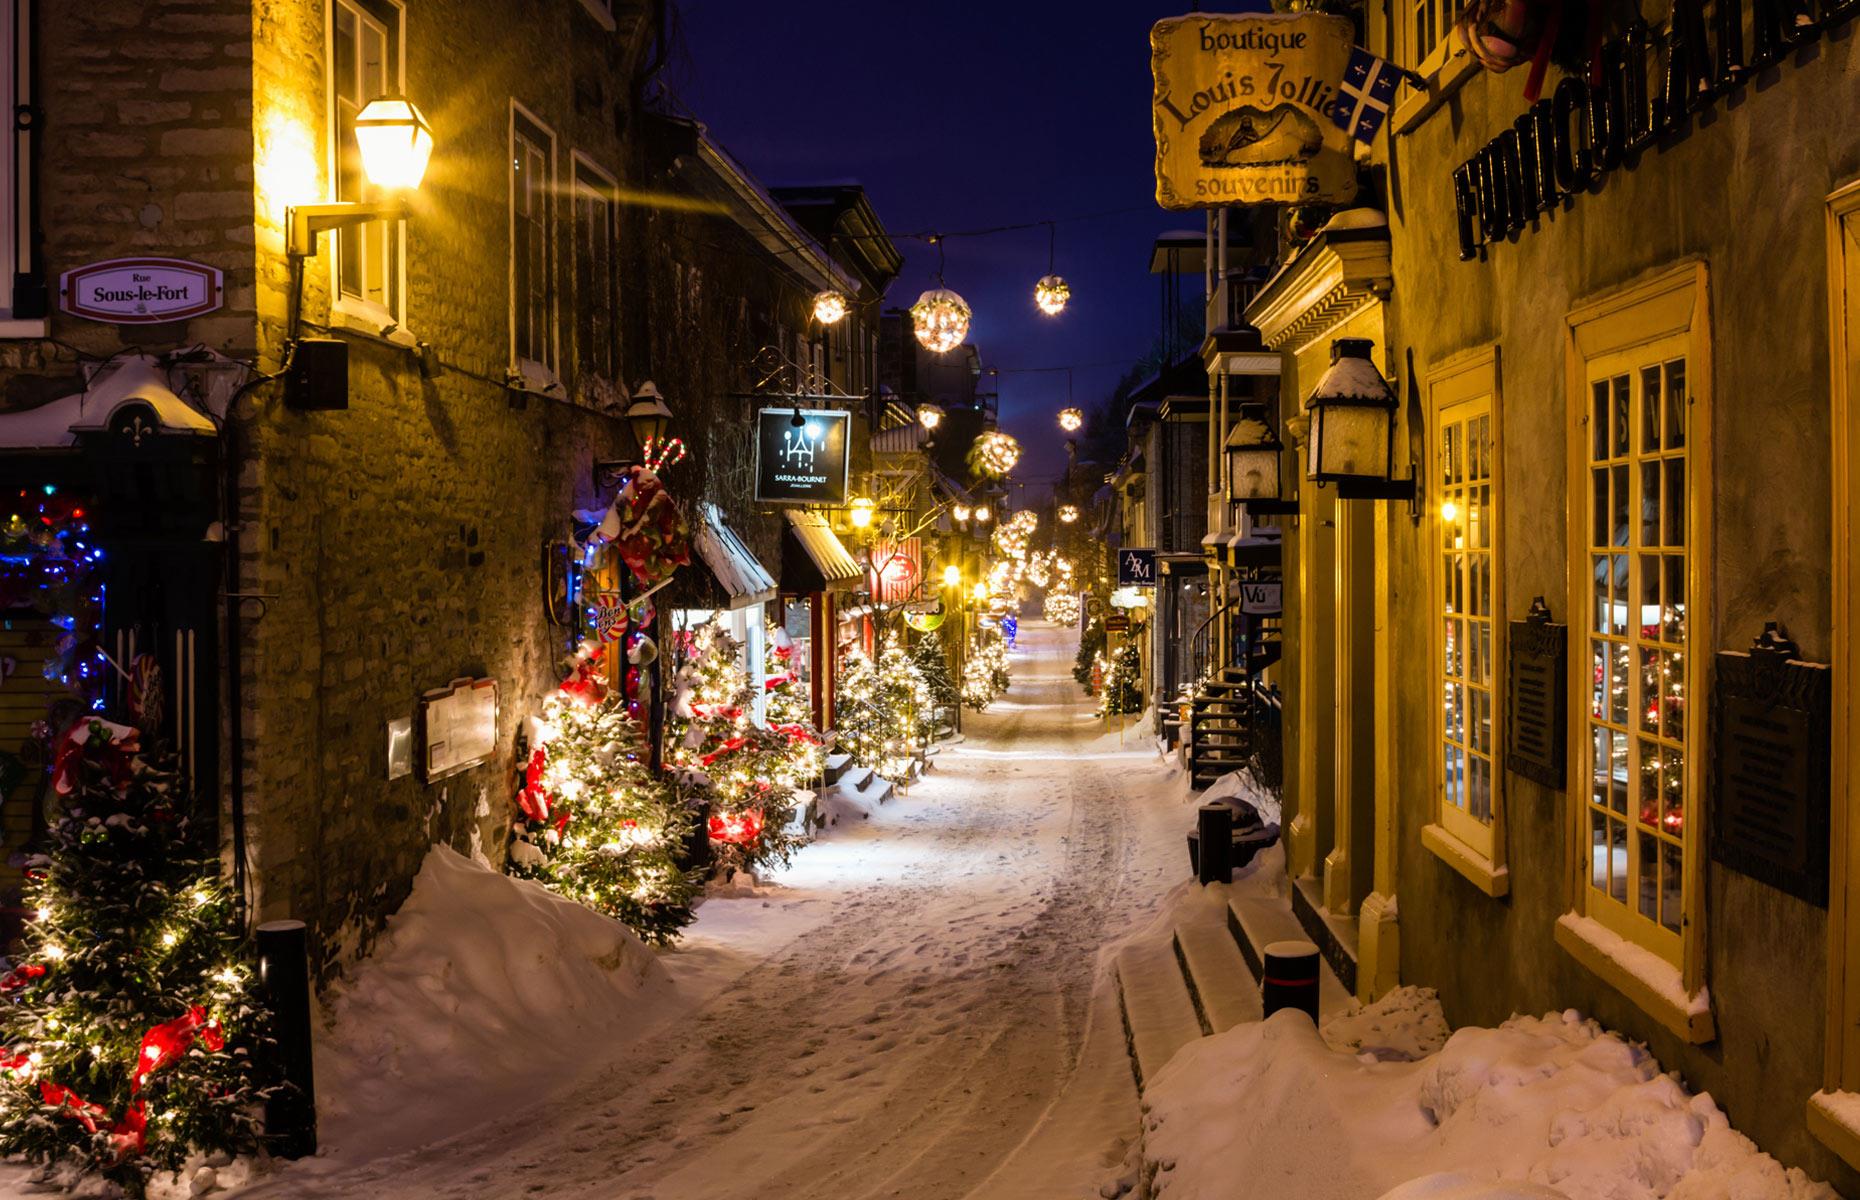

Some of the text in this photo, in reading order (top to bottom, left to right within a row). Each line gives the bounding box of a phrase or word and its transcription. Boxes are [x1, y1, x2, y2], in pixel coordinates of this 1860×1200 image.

[1199, 22, 1307, 58] boutique
[1157, 62, 1337, 133] Louis Jollie
[1195, 170, 1320, 197] souvenirs
[132, 273, 152, 283] Rue
[93, 285, 189, 303] Sous-le-Fort
